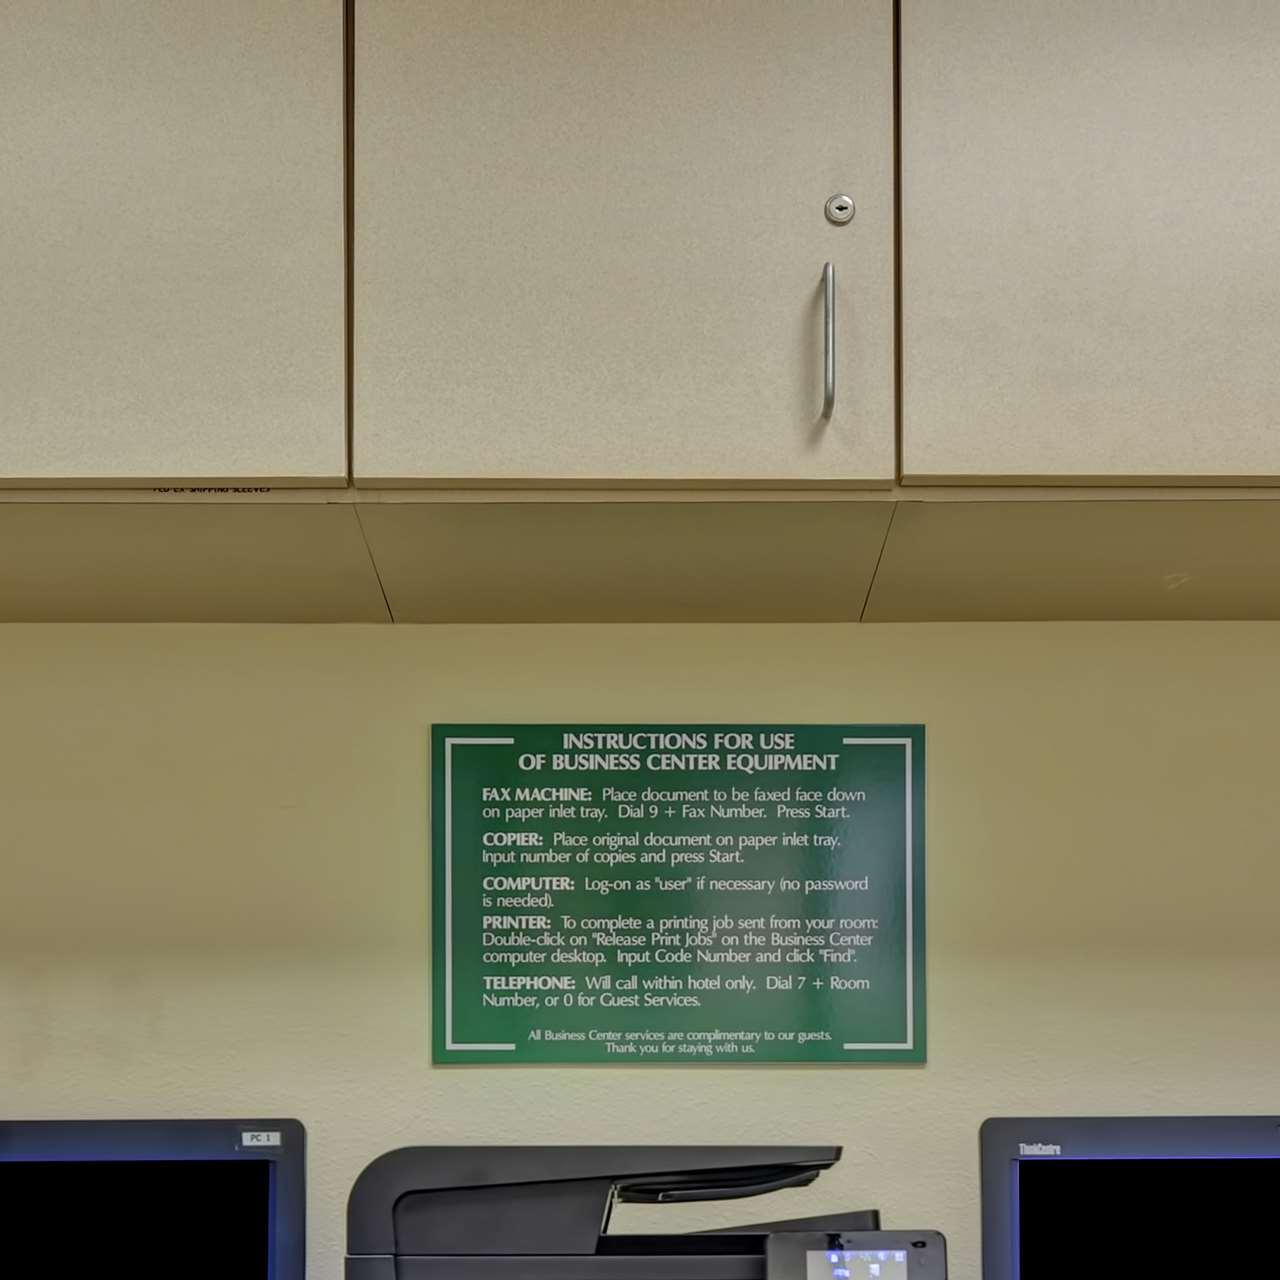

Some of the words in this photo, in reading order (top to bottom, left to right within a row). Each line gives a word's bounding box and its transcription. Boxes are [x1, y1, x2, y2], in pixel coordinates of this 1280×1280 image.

[563, 733, 707, 749] INSTRUCTIONS
[714, 733, 754, 749] FOR
[760, 733, 795, 749] USE
[518, 754, 546, 770] OF
[552, 754, 641, 770] BUSINESS
[647, 754, 721, 770] CENTER
[727, 754, 840, 774] EQUIPMENT
[482, 787, 511, 801] FAX
[515, 787, 592, 801] MACHINE:
[603, 787, 637, 801] Place
[641, 787, 710, 801] document
[714, 787, 727, 801] to
[732, 787, 749, 801] be
[754, 787, 790, 801] faxed
[795, 787, 823, 801] face
[827, 787, 865, 801] down
[482, 808, 500, 818] on
[506, 808, 544, 822] paper
[549, 804, 576, 818] inlet
[580, 804, 608, 822] tray.
[618, 804, 644, 818] Dial
[649, 804, 658, 818] 9
[683, 804, 705, 818] Fax
[711, 804, 767, 818] Number.
[777, 804, 810, 818] Press
[815, 804, 850, 818] Start.
[482, 832, 543, 846] COPIER:
[554, 832, 588, 846] Place
[592, 832, 639, 851] original
[644, 832, 712, 846] document
[716, 836, 733, 846] on
[739, 836, 778, 851] paper
[782, 832, 809, 846] inlet
[813, 832, 842, 851] tray.
[483, 849, 516, 867] Input
[520, 849, 572, 862] number
[576, 849, 590, 862] of
[594, 849, 636, 867] copies
[640, 849, 666, 862] and
[671, 853, 705, 867] press
[709, 849, 744, 862] Start.
[483, 876, 575, 890] COMPUTER:
[585, 876, 631, 895] Log-on
[636, 880, 651, 890] as
[655, 876, 692, 890] "user"
[696, 876, 706, 890] if
[710, 880, 775, 895] necessary
[780, 876, 800, 895] (no
[805, 876, 868, 895] password
[483, 893, 492, 907] is
[497, 893, 554, 909] needed).
[483, 915, 551, 929] PRINTER:
[560, 915, 576, 929] To
[581, 915, 642, 933] complete
[646, 919, 658, 929] a
[660, 915, 708, 933] printing
[713, 915, 734, 933] job
[738, 915, 765, 929] sent
[770, 915, 801, 929] from
[805, 919, 836, 933] your
[839, 919, 878, 929] room:
[483, 932, 565, 946] Double-click
[570, 936, 587, 946] on
[592, 932, 646, 946] "Release
[652, 932, 681, 946] Print
[685, 932, 717, 948] Jobs"
[721, 936, 739, 946] on
[744, 932, 766, 946] the
[771, 932, 825, 946] Business
[829, 932, 873, 946] Center
[483, 949, 547, 967] computer
[551, 949, 606, 967] desktop.
[617, 949, 651, 967] Input
[655, 949, 692, 963] Code
[697, 949, 751, 963] Number
[756, 949, 781, 963] and
[786, 949, 815, 963] click
[819, 949, 856, 963] "Find".
[483, 976, 575, 989] TELEPHONE:
[585, 976, 611, 989] Will
[615, 976, 637, 989] call
[642, 976, 683, 989] within
[688, 976, 720, 989] hotel
[725, 976, 756, 994] only.
[767, 976, 792, 989] Dial
[798, 976, 806, 989] 7
[830, 976, 869, 989] Room
[483, 992, 540, 1008] Number,
[545, 996, 559, 1006] or
[564, 992, 573, 1006] 0
[577, 992, 596, 1006] for
[600, 992, 640, 1006] Guest
[644, 992, 701, 1006] Services.
[528, 1029, 541, 1041] All
[545, 1029, 586, 1041] Business
[589, 1029, 622, 1041] Center
[624, 1029, 665, 1041] services
[667, 1033, 684, 1041] are
[687, 1029, 761, 1044] complimentary
[764, 1029, 775, 1041] to
[778, 1033, 795, 1041] our
[798, 1029, 832, 1044] guests.
[605, 1042, 636, 1052] Thank
[639, 1045, 659, 1056] you
[662, 1042, 675, 1052] for
[678, 1042, 713, 1056] staying
[715, 1042, 738, 1052] with
[250, 1133, 262, 1142] PC
